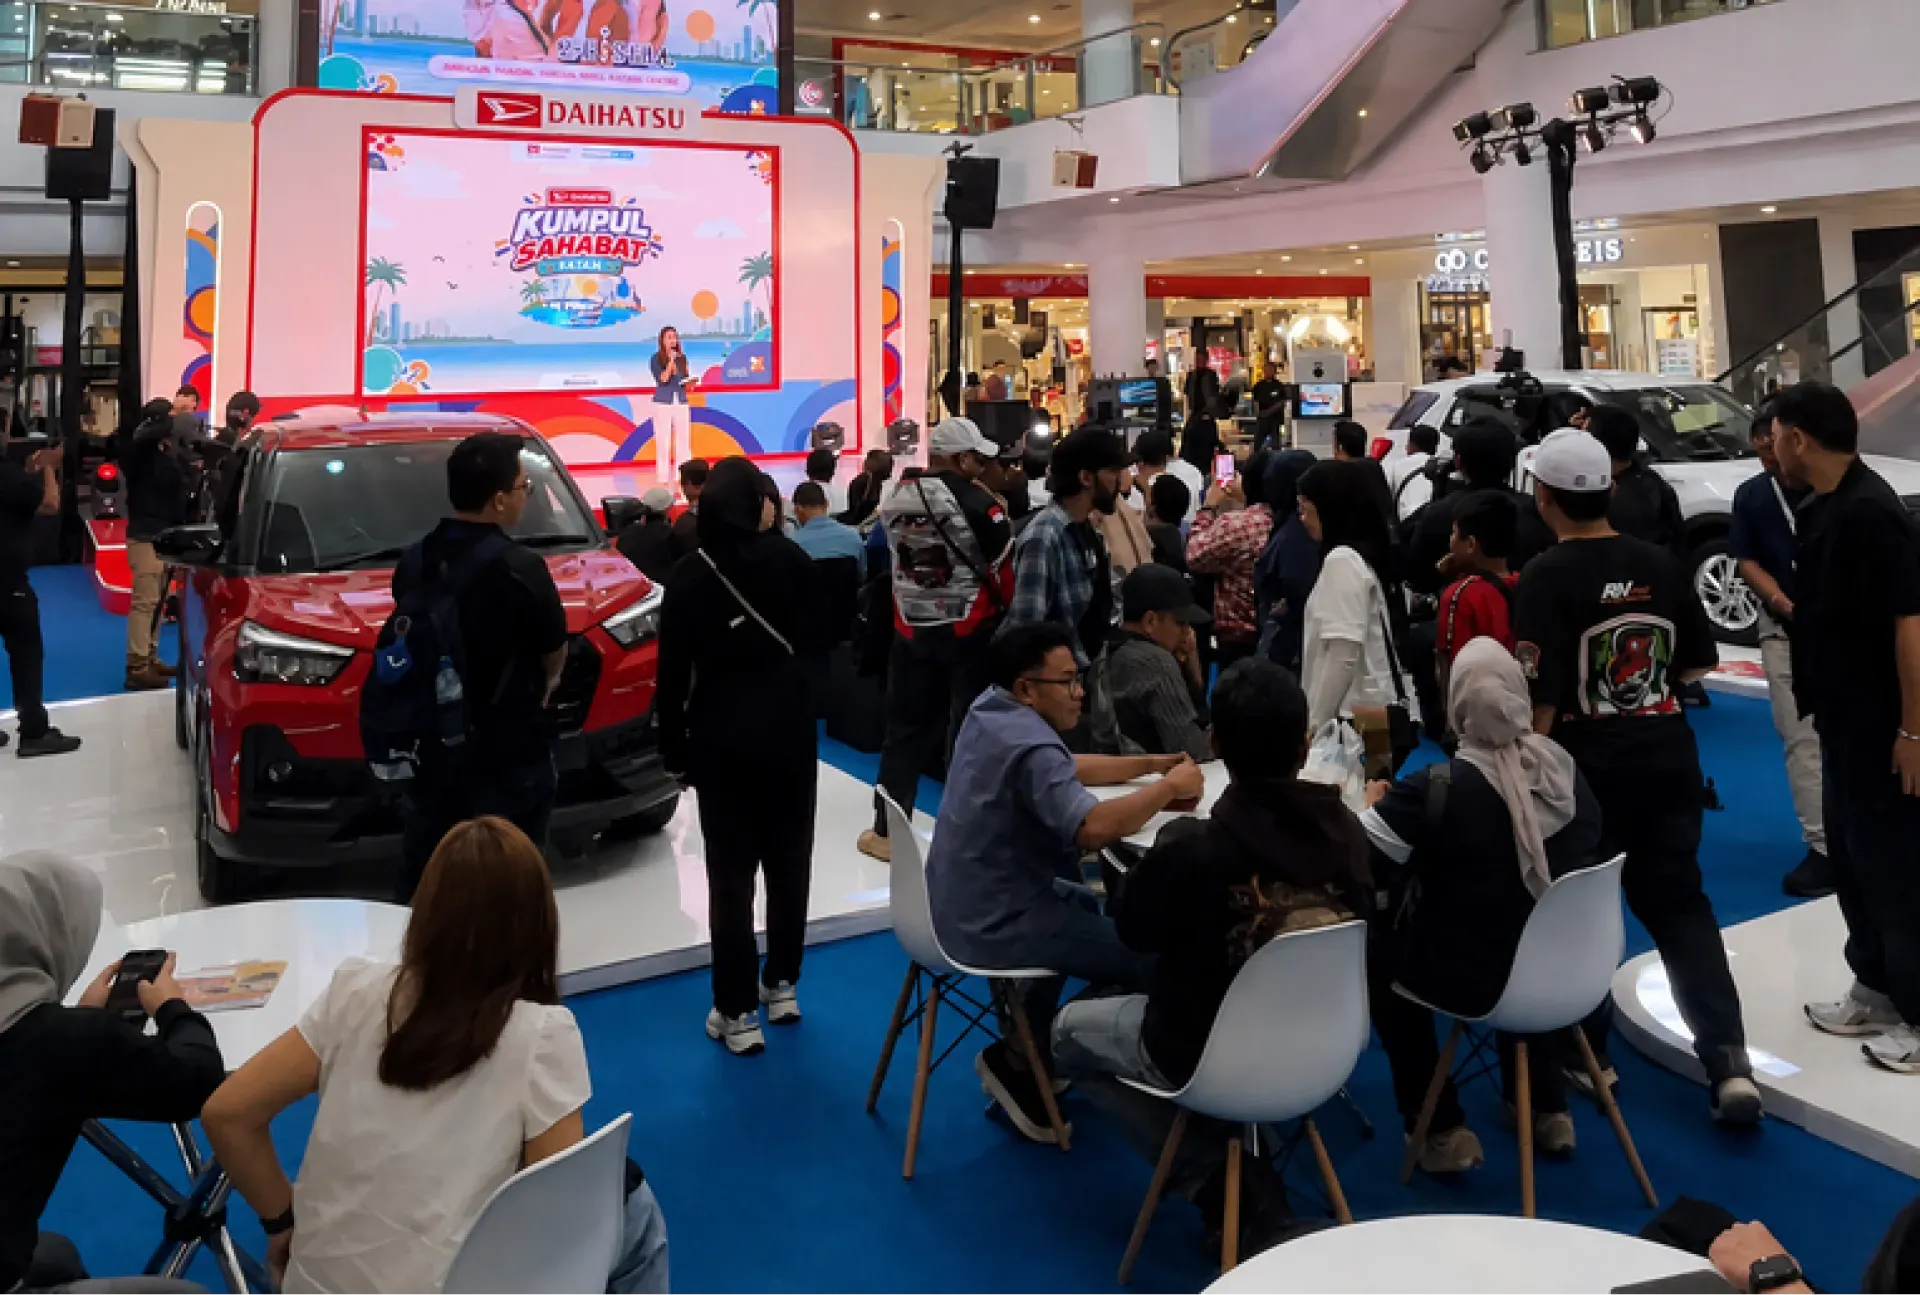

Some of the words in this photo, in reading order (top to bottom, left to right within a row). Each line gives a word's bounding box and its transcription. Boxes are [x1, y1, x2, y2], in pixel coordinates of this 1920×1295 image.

[548, 100, 685, 130] DAIHATSU
[514, 209, 650, 242] KUMPUL
[517, 235, 647, 265] SAHABAT
